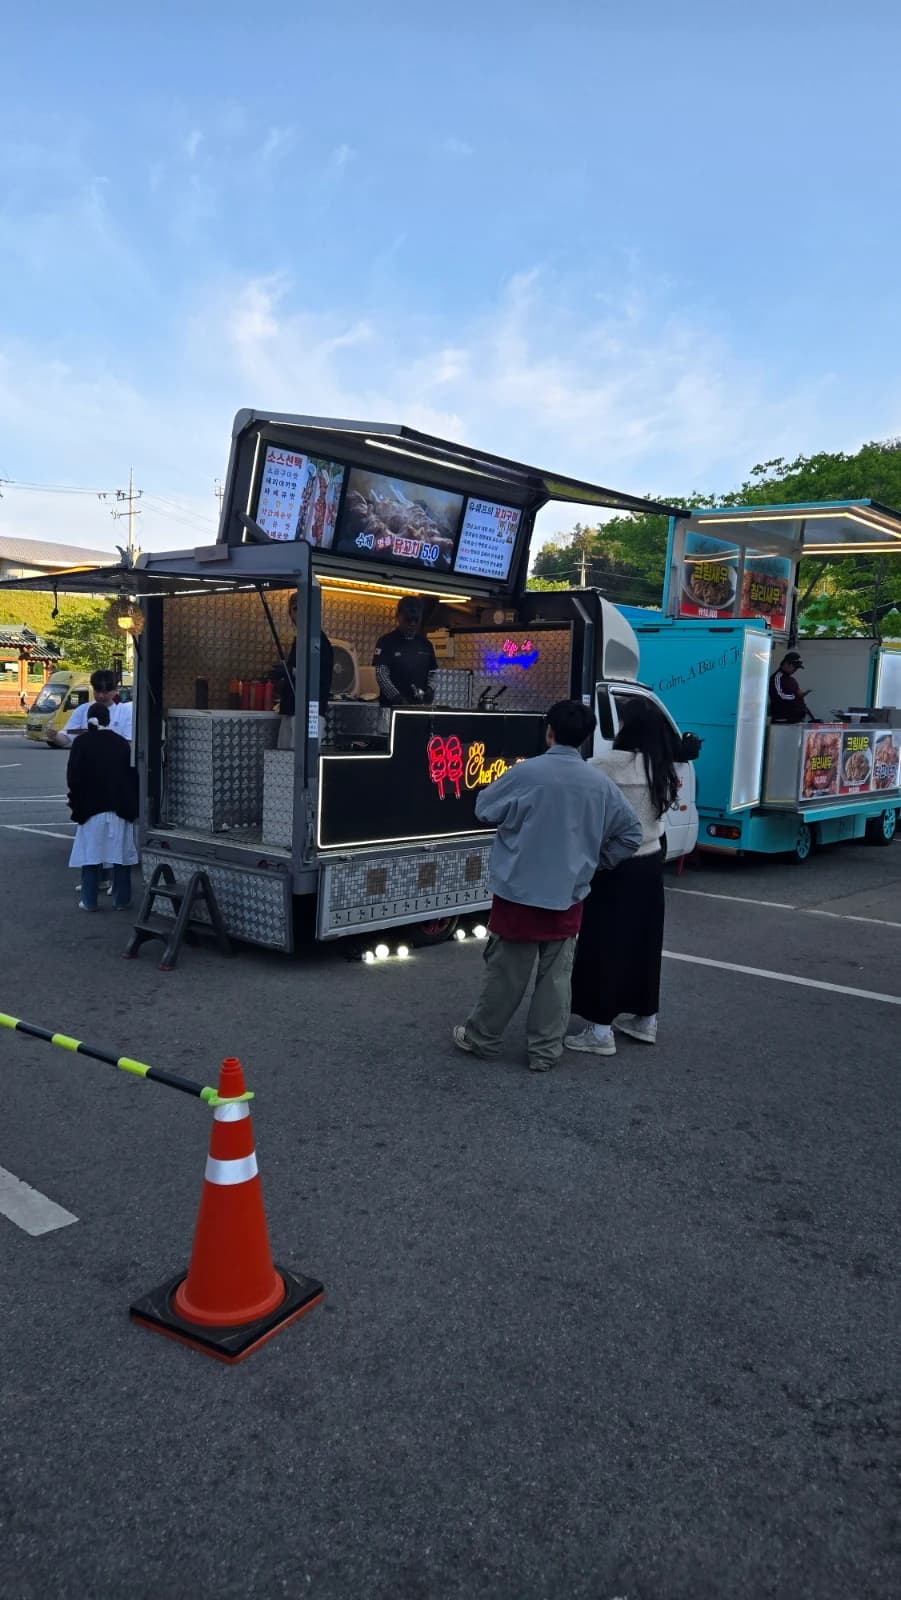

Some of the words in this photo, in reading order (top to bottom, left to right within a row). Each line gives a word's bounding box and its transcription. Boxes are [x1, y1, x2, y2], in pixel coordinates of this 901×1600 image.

[267, 450, 303, 469] 소스선택
[355, 532, 375, 550] 수제
[392, 536, 420, 559] 닭꼬치
[421, 543, 440, 561] 5.0
[694, 561, 729, 585] 크림새우
[750, 582, 780, 605] 칠리새우
[688, 665, 697, 680] A
[847, 736, 869, 751] 크림새우
[811, 756, 833, 770] 칠리새우
